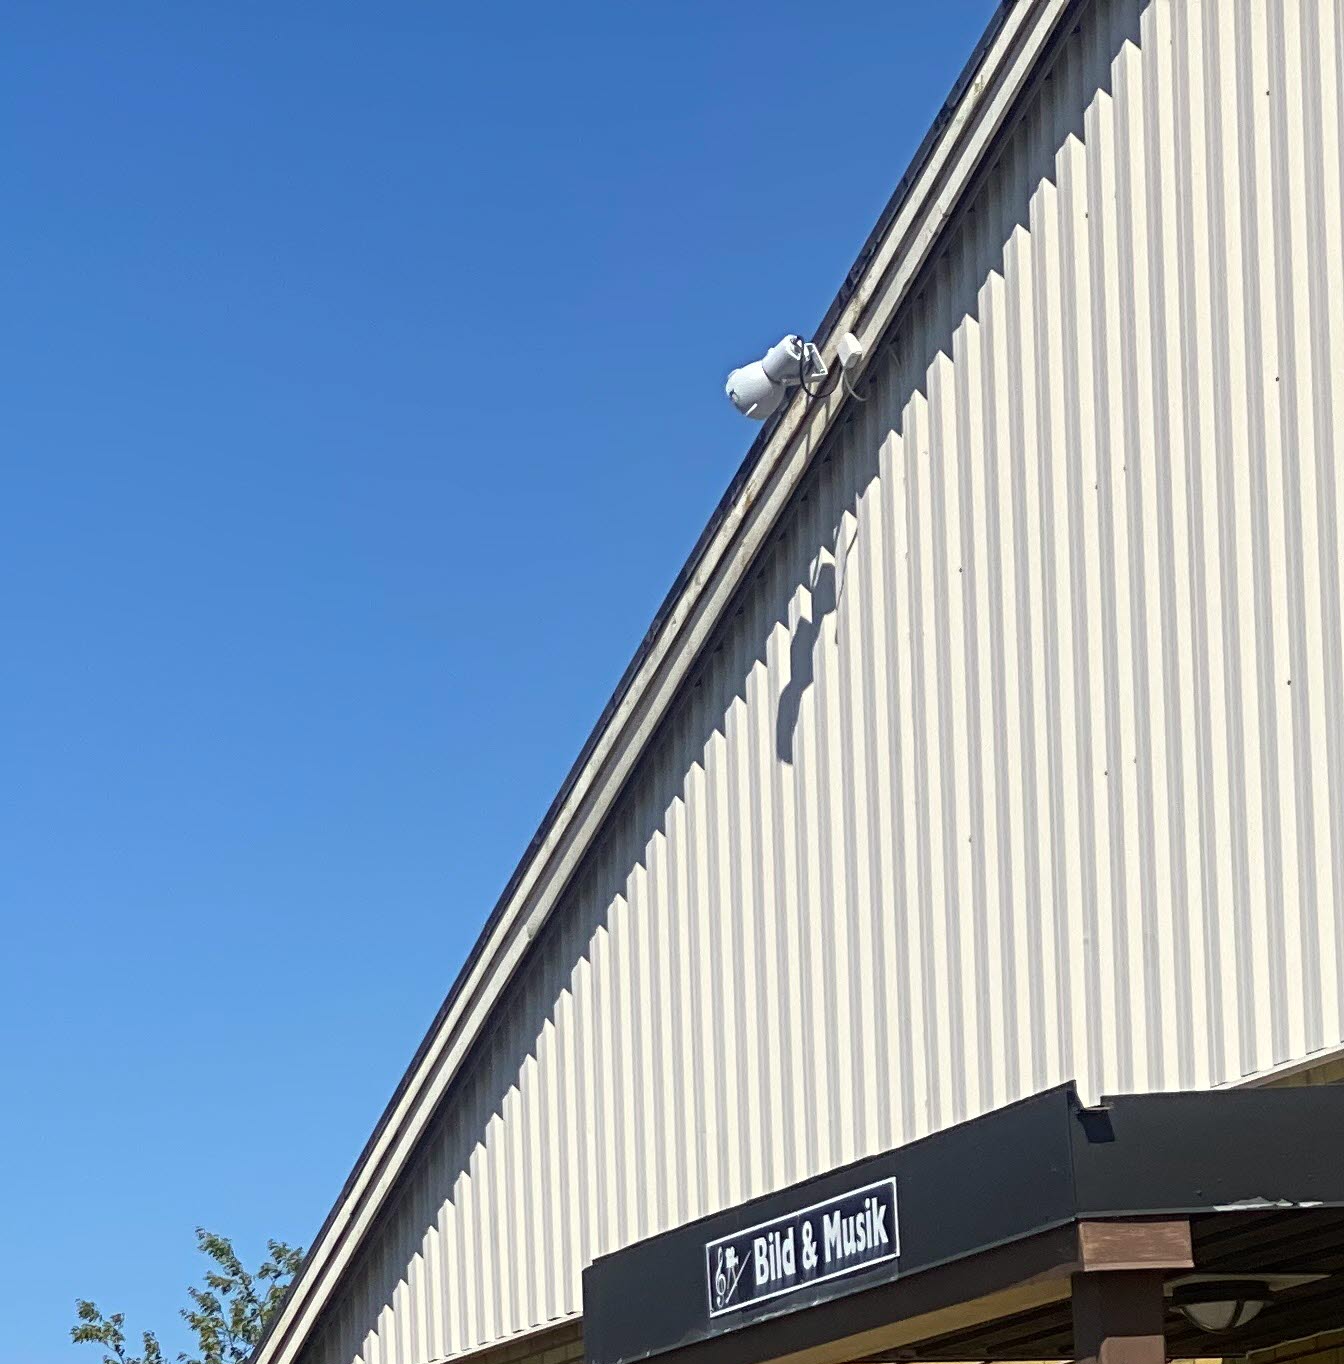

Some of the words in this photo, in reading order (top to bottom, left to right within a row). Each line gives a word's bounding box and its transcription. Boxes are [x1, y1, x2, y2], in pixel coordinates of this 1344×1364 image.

[753, 1226, 796, 1285] Bild
[802, 1220, 819, 1269] &
[823, 1197, 889, 1262] Musik
